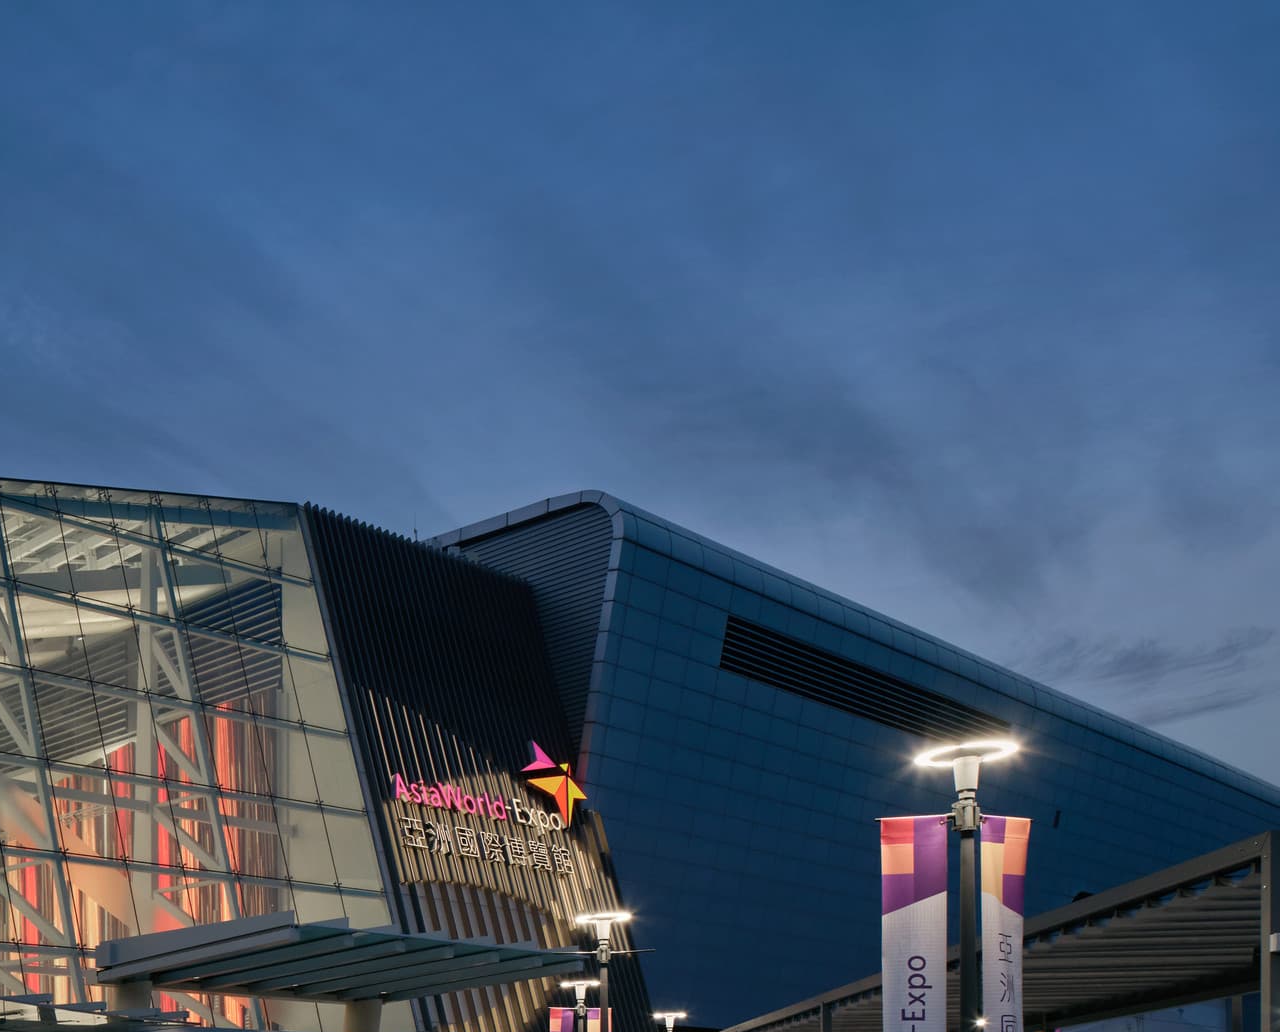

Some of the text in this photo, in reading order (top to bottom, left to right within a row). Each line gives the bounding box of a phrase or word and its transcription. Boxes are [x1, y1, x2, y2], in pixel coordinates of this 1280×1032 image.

[394, 773, 561, 834] AsiaWorld-Expo
[400, 816, 574, 875] 亞洲國際博覽館
